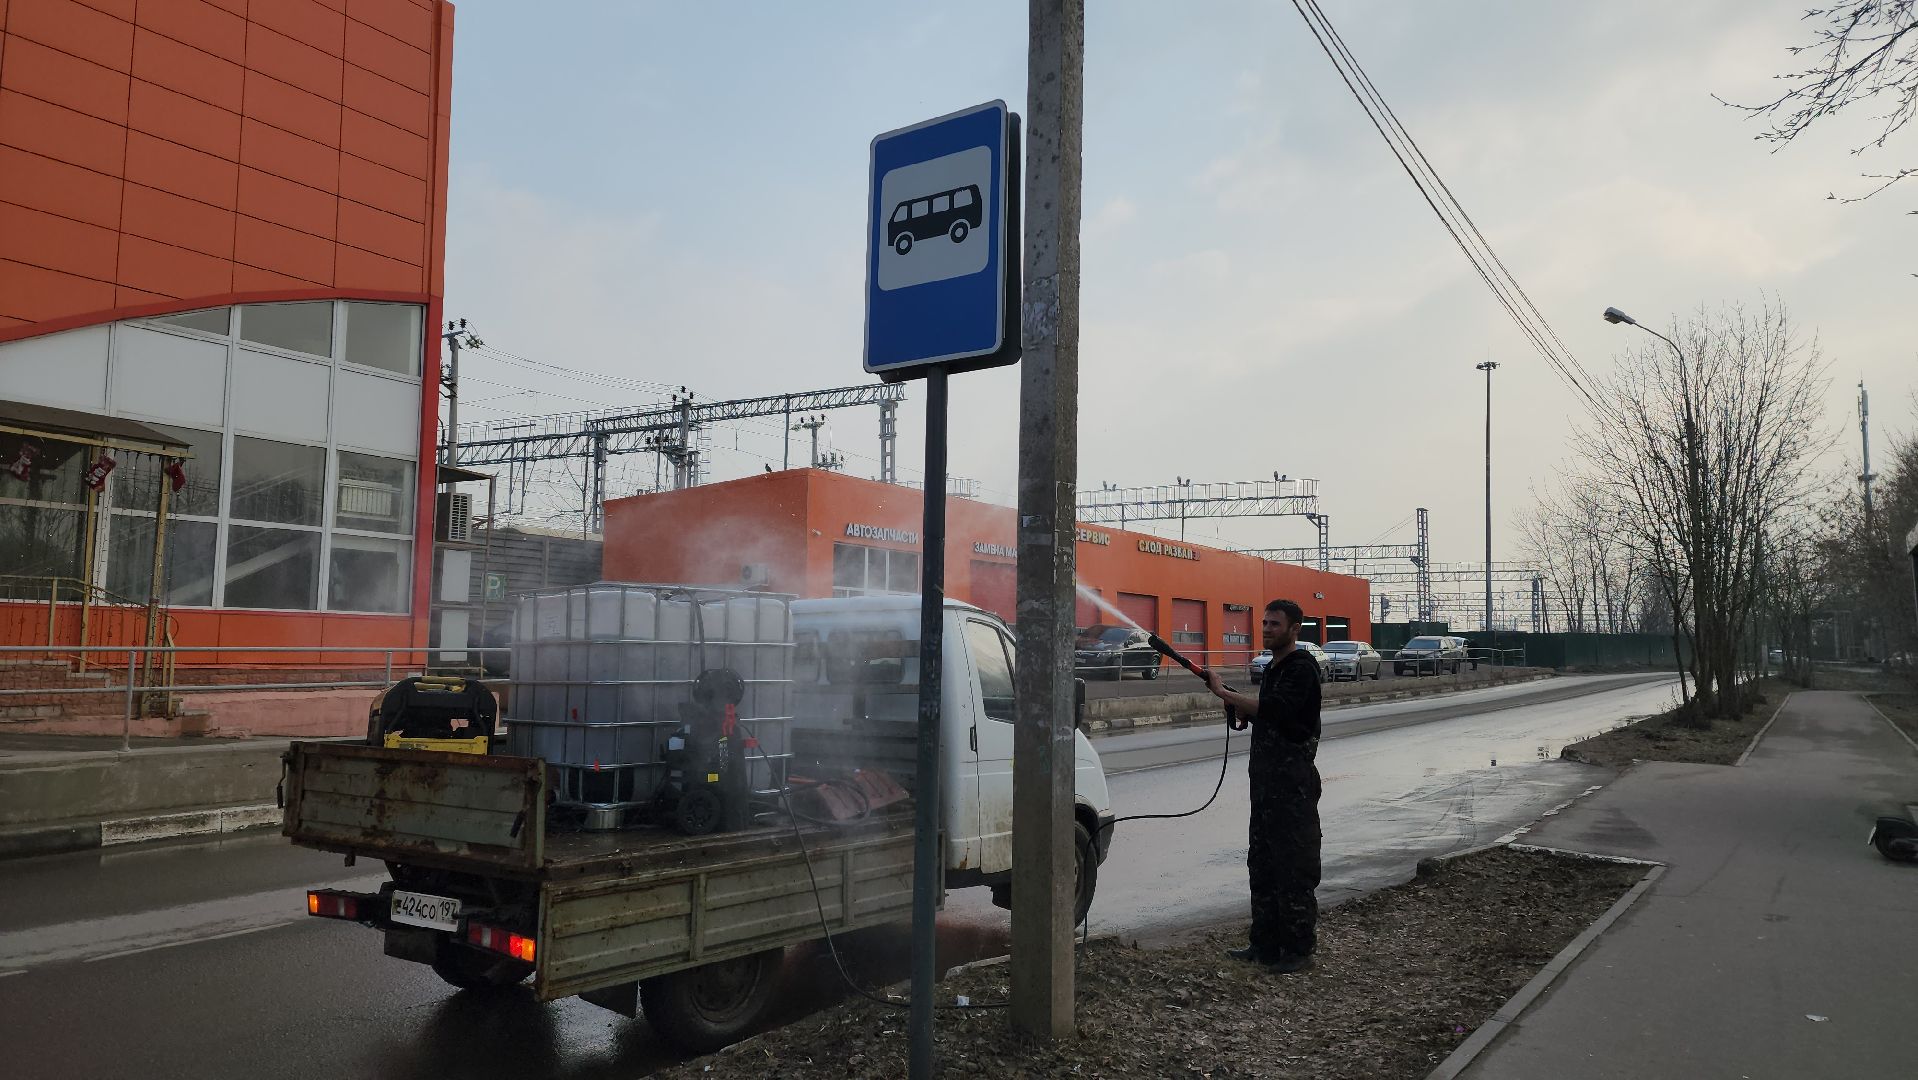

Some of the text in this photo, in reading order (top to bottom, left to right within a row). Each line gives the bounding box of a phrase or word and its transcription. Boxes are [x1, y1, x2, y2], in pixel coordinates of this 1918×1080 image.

[846, 522, 919, 544] АВТОЗАПЧАСТИ
[1139, 540, 1162, 555] СХОД
[1164, 544, 1193, 560] РАЗВАЛ
